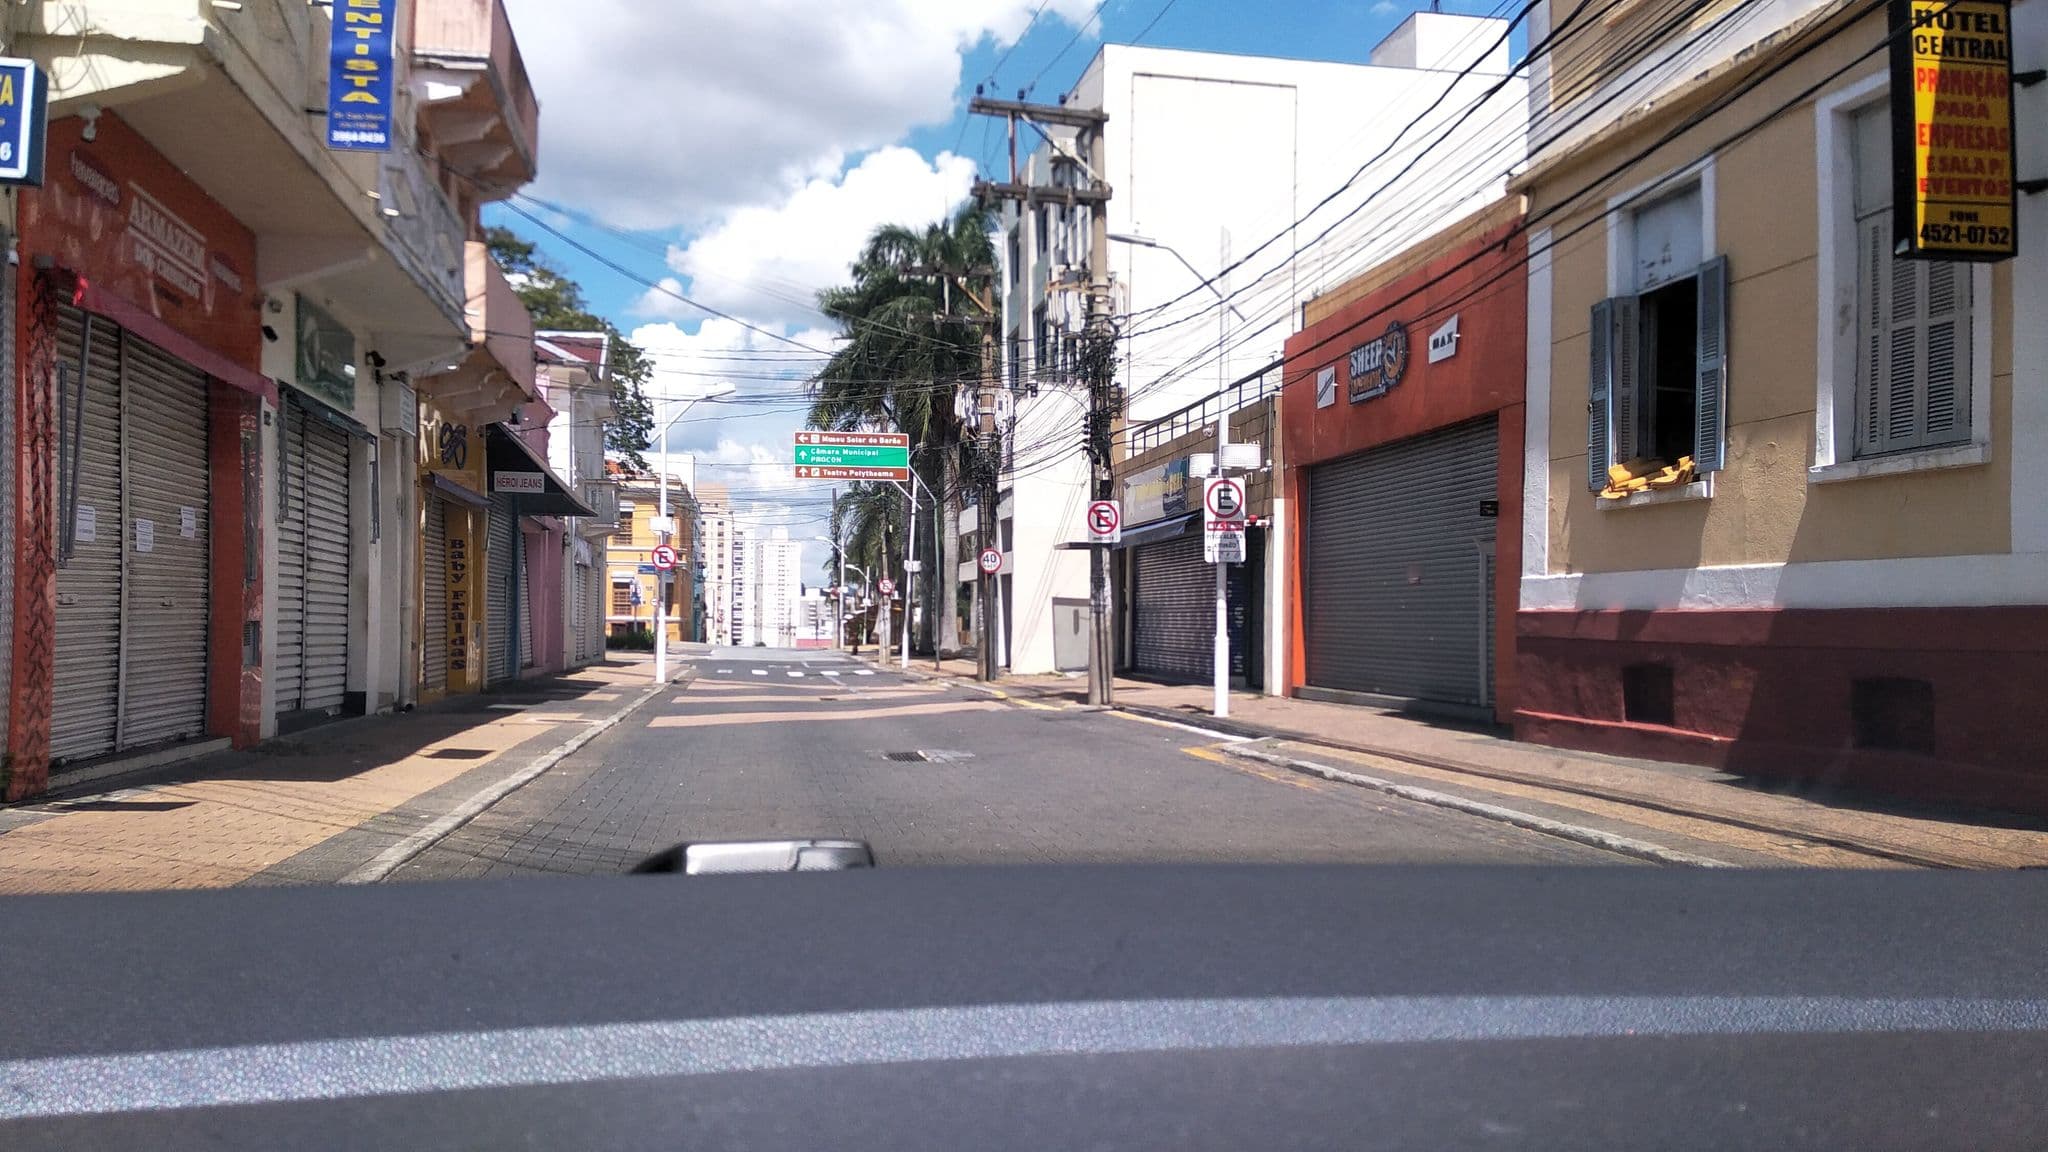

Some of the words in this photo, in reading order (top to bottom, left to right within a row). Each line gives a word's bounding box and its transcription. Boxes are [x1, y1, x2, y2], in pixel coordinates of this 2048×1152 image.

[1914, 9, 2004, 35] HOTEL
[1914, 34, 2008, 60] CENTRAL
[1916, 67, 2009, 100] PROMOÇÃO
[1934, 101, 1990, 120] PARA
[1917, 123, 2009, 152] EMPRESAS
[1937, 156, 1985, 175] SALA
[1919, 178, 2010, 197] EVENTOS
[1920, 224, 2010, 246] 4521-0752
[1350, 338, 1383, 378] SHEEP
[821, 435, 845, 443] Museu
[846, 436, 867, 444] Solar
[868, 436, 878, 444] do
[879, 436, 902, 445] Barão
[810, 448, 840, 456] Câmara
[842, 449, 879, 457] Municipal
[520, 478, 543, 489] JEANS
[822, 469, 848, 477] Teatro
[849, 470, 894, 478] Polytheama
[450, 539, 466, 584] Baby
[983, 553, 998, 564] 40
[450, 590, 467, 671] Fraldas
